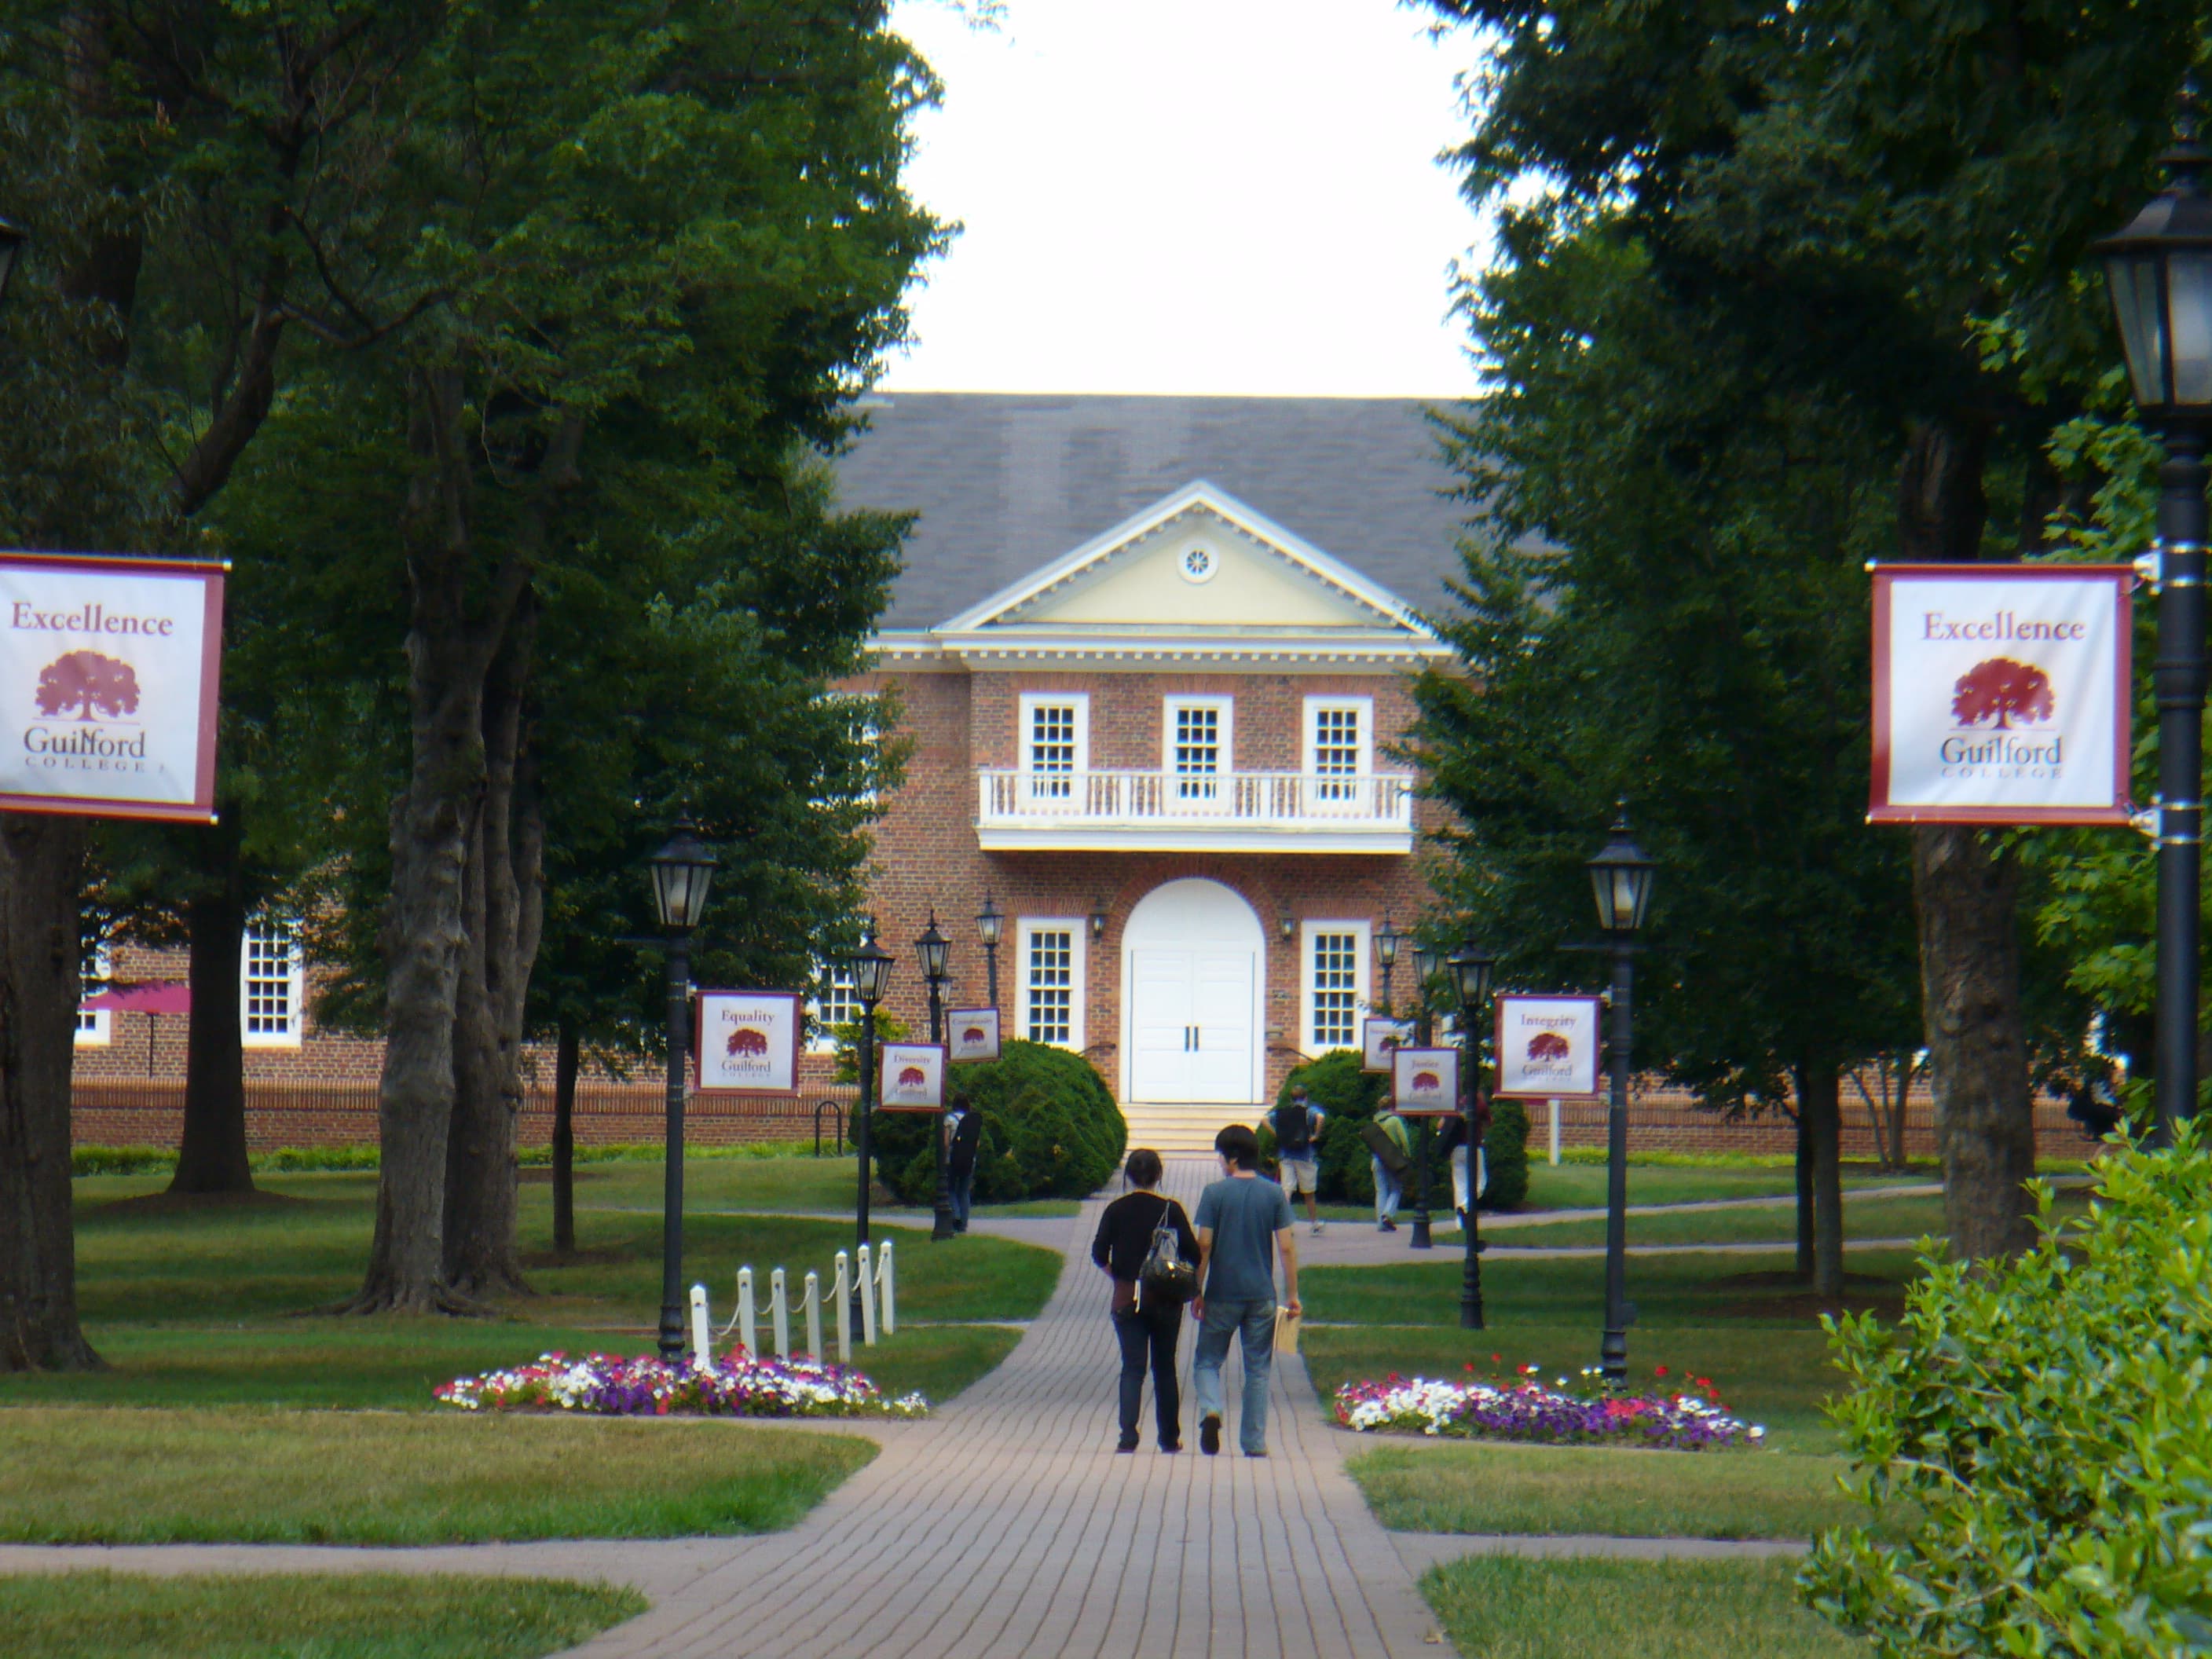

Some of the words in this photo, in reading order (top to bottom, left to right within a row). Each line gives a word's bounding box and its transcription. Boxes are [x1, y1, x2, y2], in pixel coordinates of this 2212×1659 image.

[12, 601, 174, 636] Excellence
[1923, 610, 2086, 641] Excellence
[24, 726, 145, 758] Guilford
[1940, 735, 2063, 765] Guilford
[25, 756, 145, 773] COLLEGE
[1941, 766, 2062, 780] COLLEGE
[722, 1009, 774, 1025] Equality
[1521, 1014, 1577, 1029] Integrity
[722, 1060, 771, 1072] Guilford
[893, 1055, 931, 1065] Diversity
